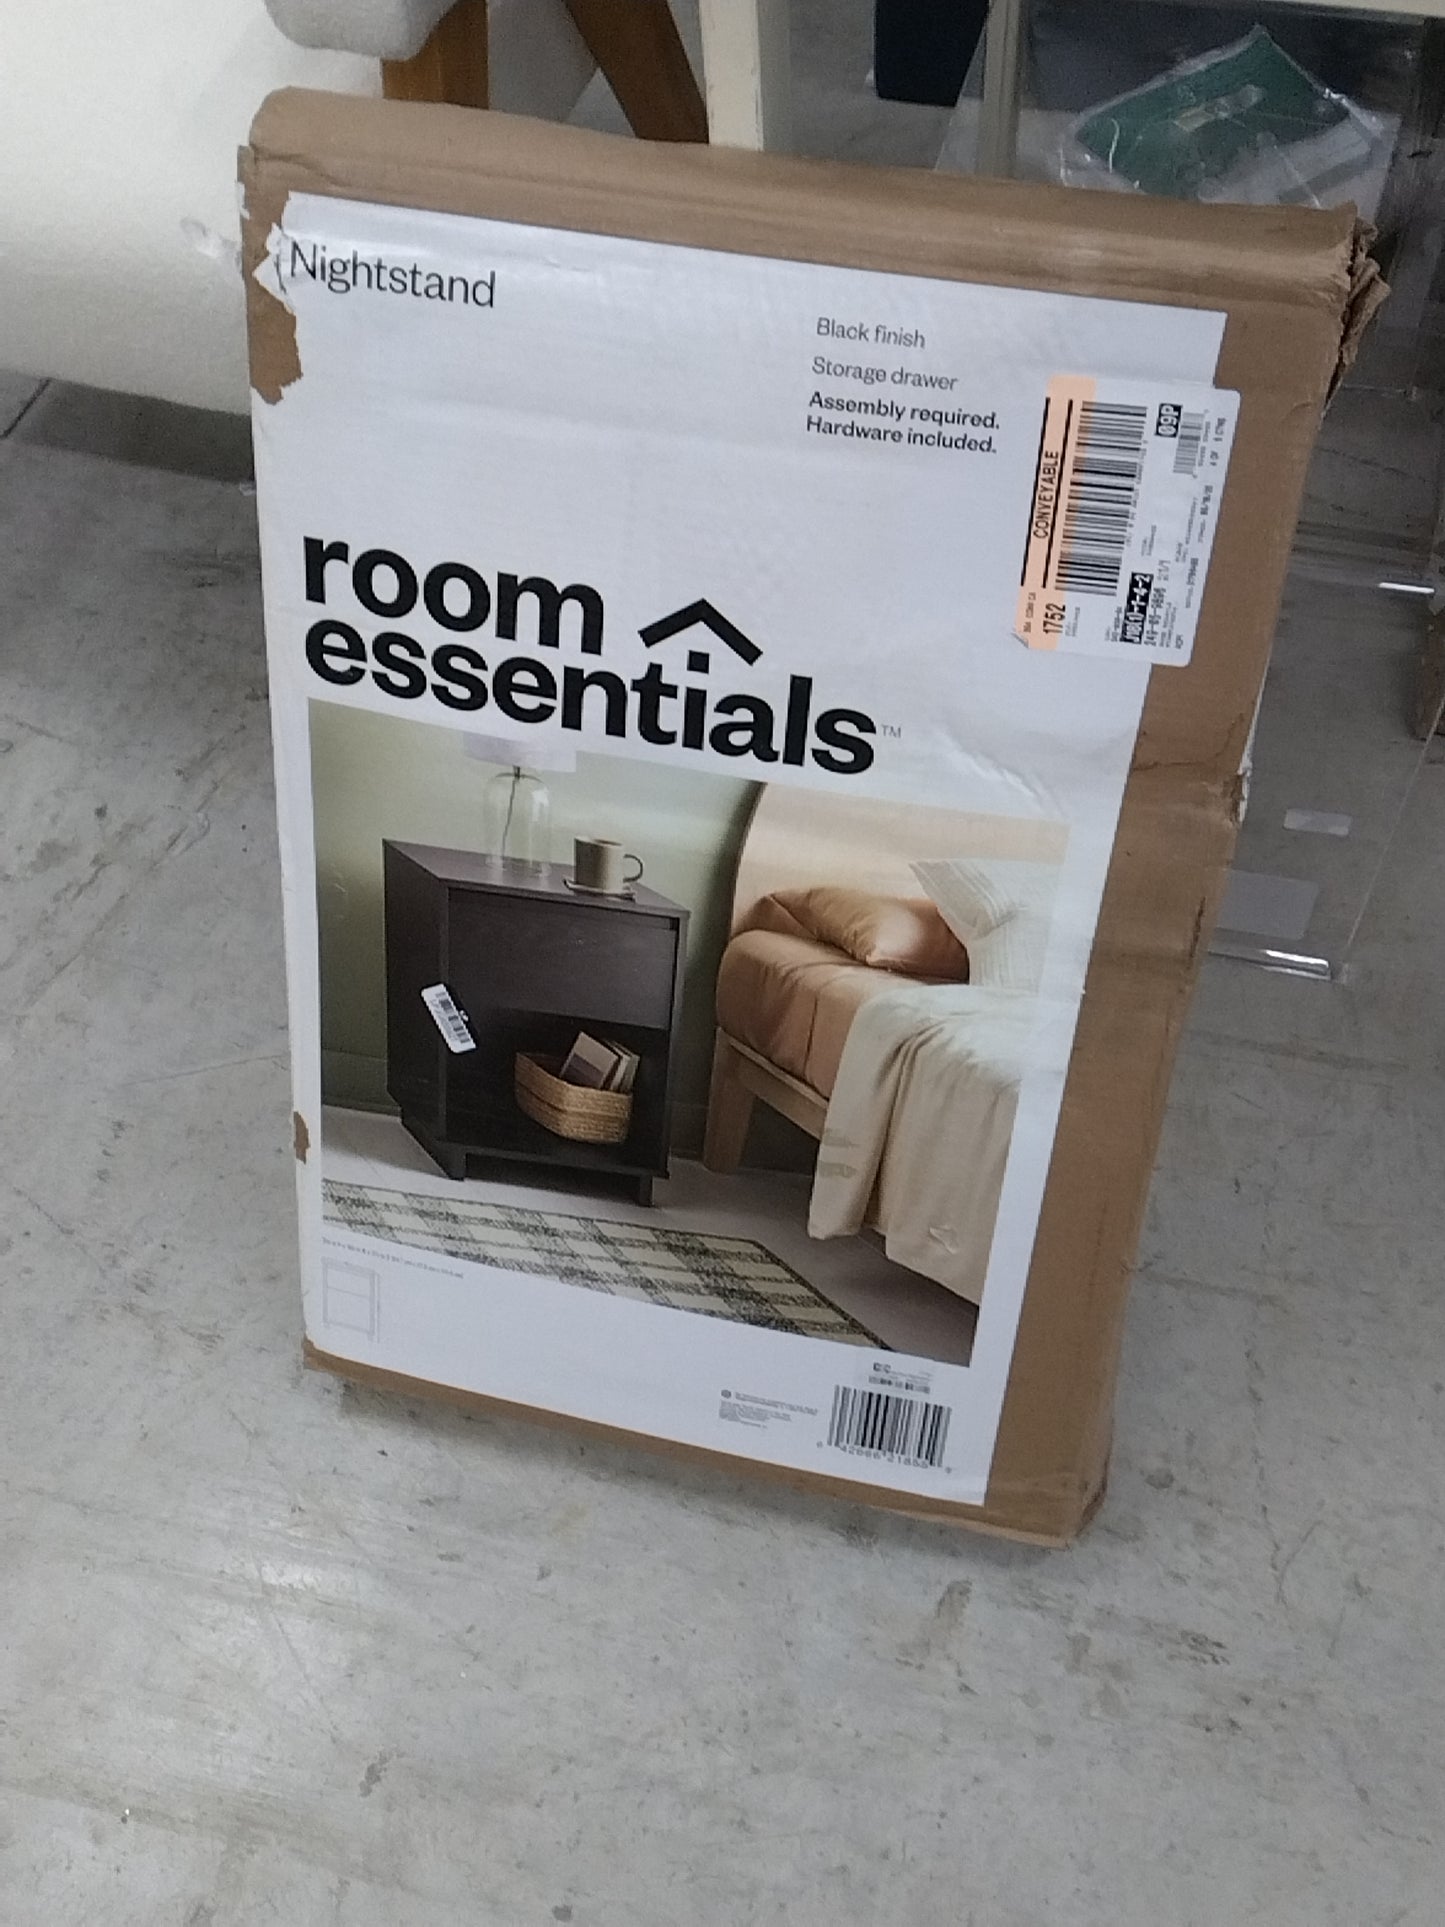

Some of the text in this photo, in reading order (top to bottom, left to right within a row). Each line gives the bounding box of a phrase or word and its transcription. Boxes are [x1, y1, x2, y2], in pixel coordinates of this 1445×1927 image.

[290, 240, 496, 308] Nightstand
[816, 316, 926, 349] Black finish
[811, 355, 958, 391] Storage drawer
[808, 390, 1000, 430] Assembly required.
[806, 414, 997, 453] Hardware included.
[1033, 451, 1059, 539] CONVEYABLE
[304, 536, 604, 655] room
[1042, 602, 1066, 634] 1752
[305, 619, 877, 775] essentials
